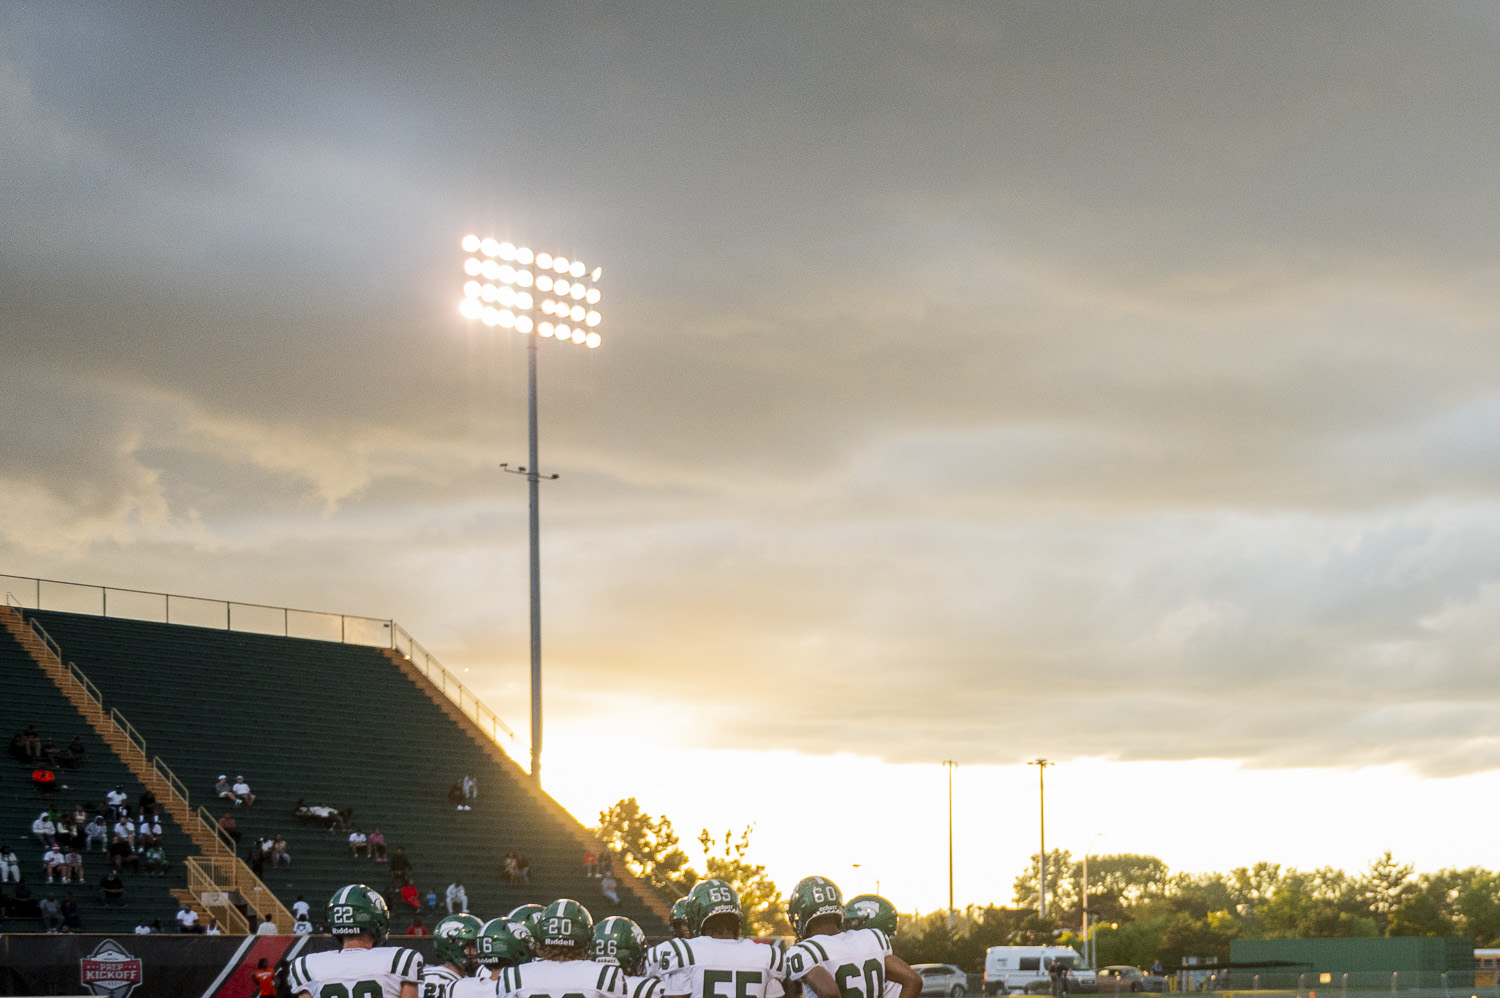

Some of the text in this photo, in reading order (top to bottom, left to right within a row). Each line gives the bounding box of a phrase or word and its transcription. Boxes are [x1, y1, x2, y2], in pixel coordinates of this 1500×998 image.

[709, 887, 731, 902] 55
[813, 886, 837, 903] 60
[333, 906, 354, 924] 22
[332, 927, 360, 935] Riddell
[549, 918, 572, 936] 20
[476, 937, 493, 954] 16
[545, 937, 575, 946] Riddell
[596, 940, 617, 955] 26
[100, 963, 124, 971] PREP
[660, 951, 673, 970] 5
[86, 970, 137, 980] KICKOFF
